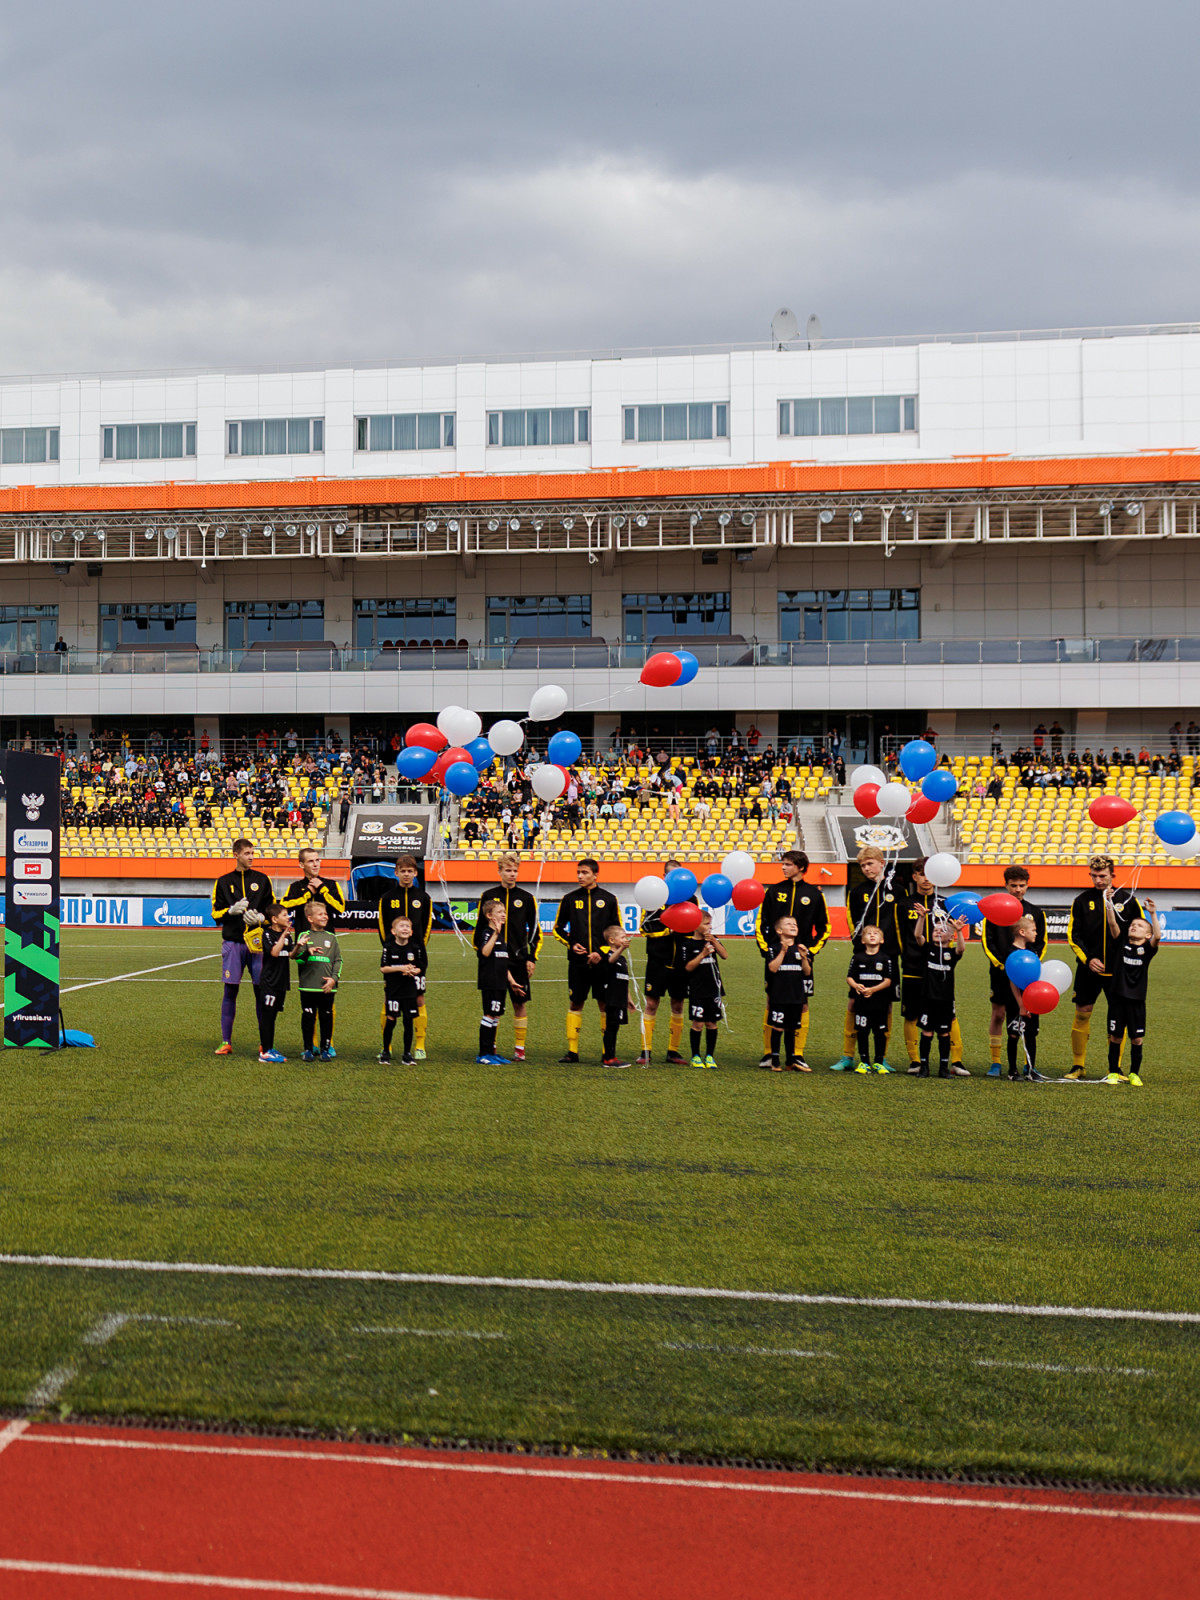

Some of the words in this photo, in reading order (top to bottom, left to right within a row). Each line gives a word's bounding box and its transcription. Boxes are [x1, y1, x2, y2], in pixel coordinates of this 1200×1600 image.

[230, 885, 234, 893] 1
[776, 892, 787, 903] 32
[863, 893, 869, 903] 6
[574, 900, 584, 910] 10
[1089, 901, 1095, 911] 9
[60, 898, 128, 924] ПРОМ
[339, 910, 379, 919] ФУТБОЛ
[908, 910, 918, 920] 23
[168, 915, 203, 925] ГАЗПРОМ
[1166, 929, 1200, 940] ГАЗПРО
[265, 994, 276, 1007] 17
[387, 1000, 399, 1012] 10
[771, 1011, 785, 1024] 32
[1110, 1019, 1116, 1031] 5
